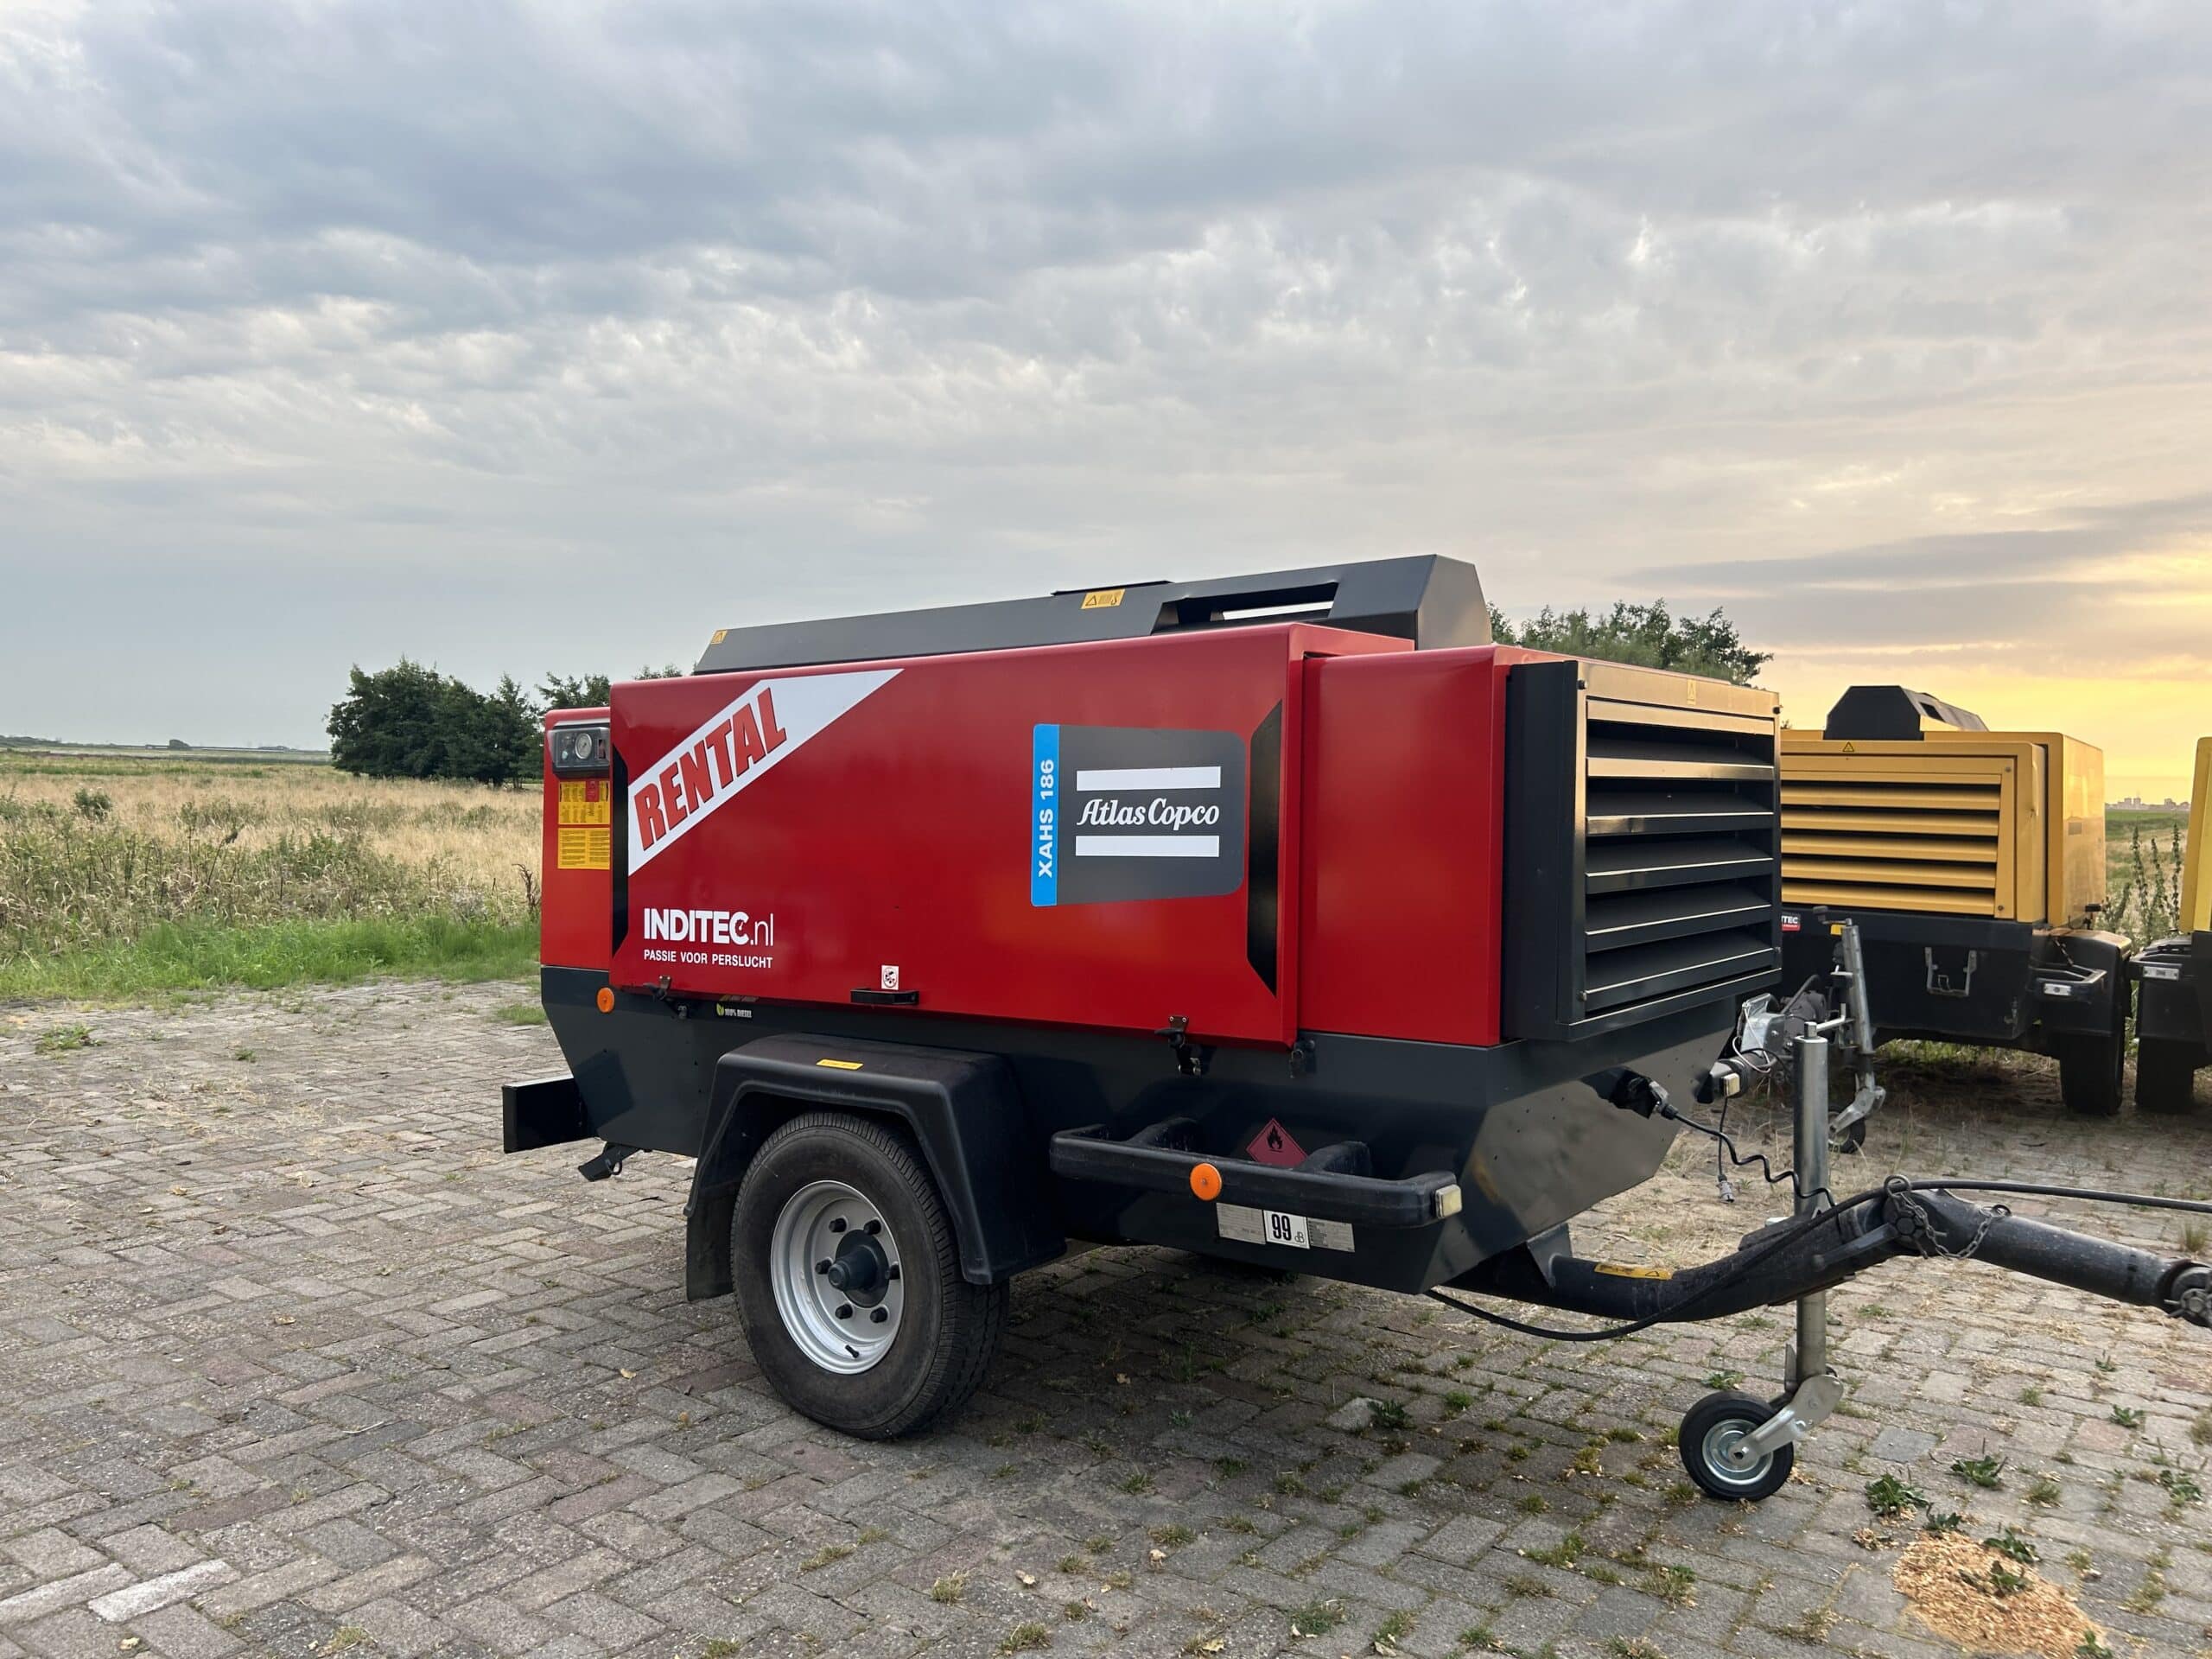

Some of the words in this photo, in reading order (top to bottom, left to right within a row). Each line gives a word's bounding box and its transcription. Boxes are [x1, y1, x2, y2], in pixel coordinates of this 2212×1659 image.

[634, 687, 787, 851] RENTAL
[1040, 760, 1053, 800] 186
[1039, 809, 1053, 878] XAHS
[644, 908, 773, 946] INDITEC.nl
[644, 949, 677, 962] PASSIE
[680, 951, 708, 964] VOOR
[712, 954, 772, 968] PERSLUCHT
[1271, 1213, 1292, 1241] 99
[1294, 1231, 1305, 1243] dB
